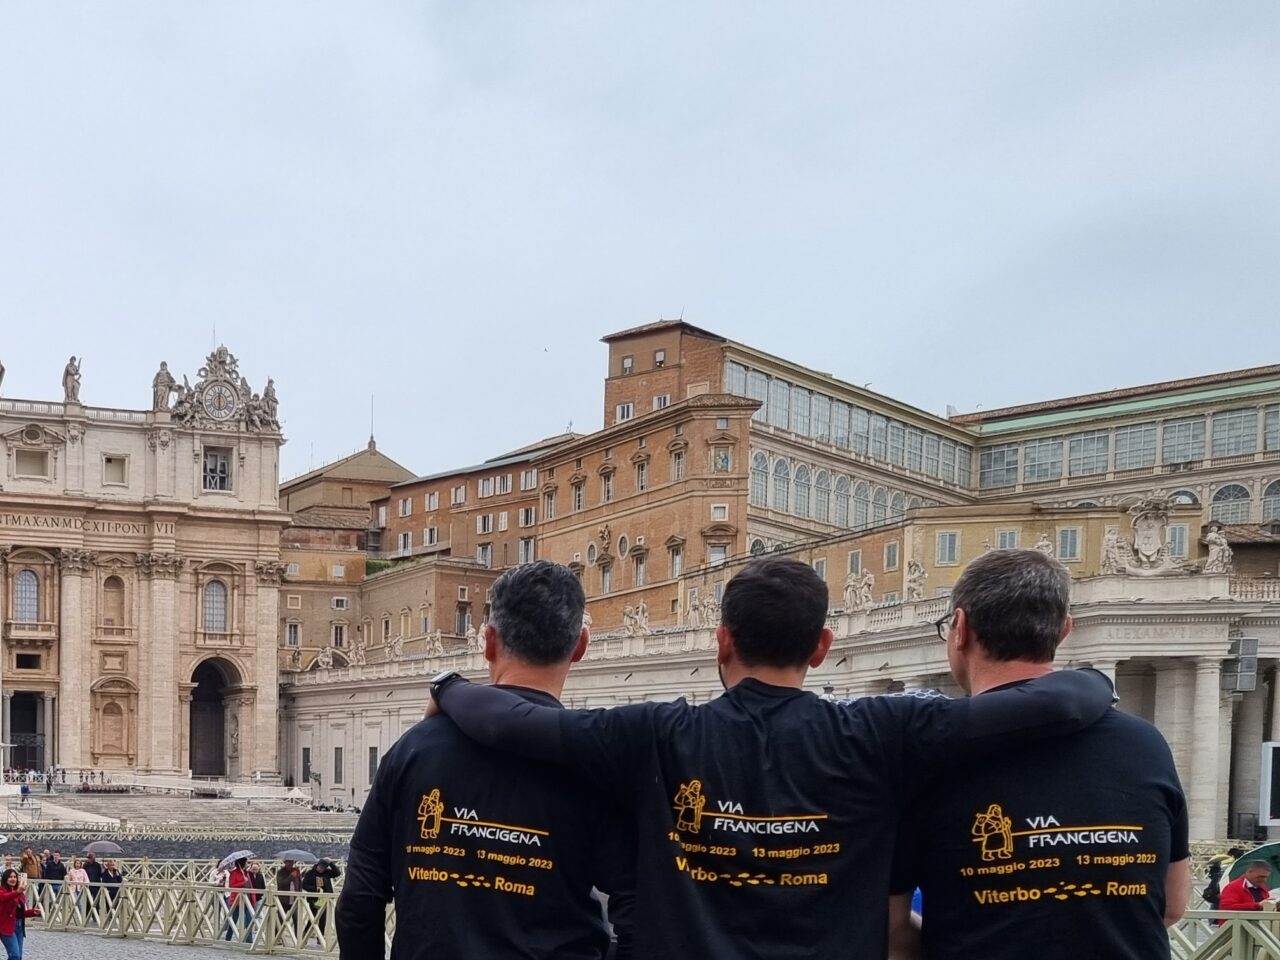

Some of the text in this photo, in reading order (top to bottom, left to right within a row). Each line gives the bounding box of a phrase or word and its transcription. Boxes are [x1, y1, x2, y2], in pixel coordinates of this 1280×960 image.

[453, 807, 479, 821] VIA
[718, 800, 744, 815] VIA
[713, 818, 820, 834] FRANCIGENA
[1025, 815, 1060, 829] VIA
[450, 823, 541, 847] FRANCIGENA
[1028, 831, 1139, 848] FRANCIGENA
[412, 845, 441, 855] maggio
[443, 845, 466, 857] 2023
[476, 850, 486, 859] 13
[487, 852, 526, 866] maggio
[528, 857, 553, 870] 2023
[709, 845, 737, 857] 2023
[752, 847, 766, 858] 13
[768, 846, 811, 859] maggio
[813, 843, 840, 854] 2023
[960, 853, 1157, 876] 10 maggio 2023 13 maggio 2023
[408, 866, 535, 896] Viterbo Roma
[780, 872, 828, 886] Roma
[974, 881, 1147, 905] Viterbo Roma
